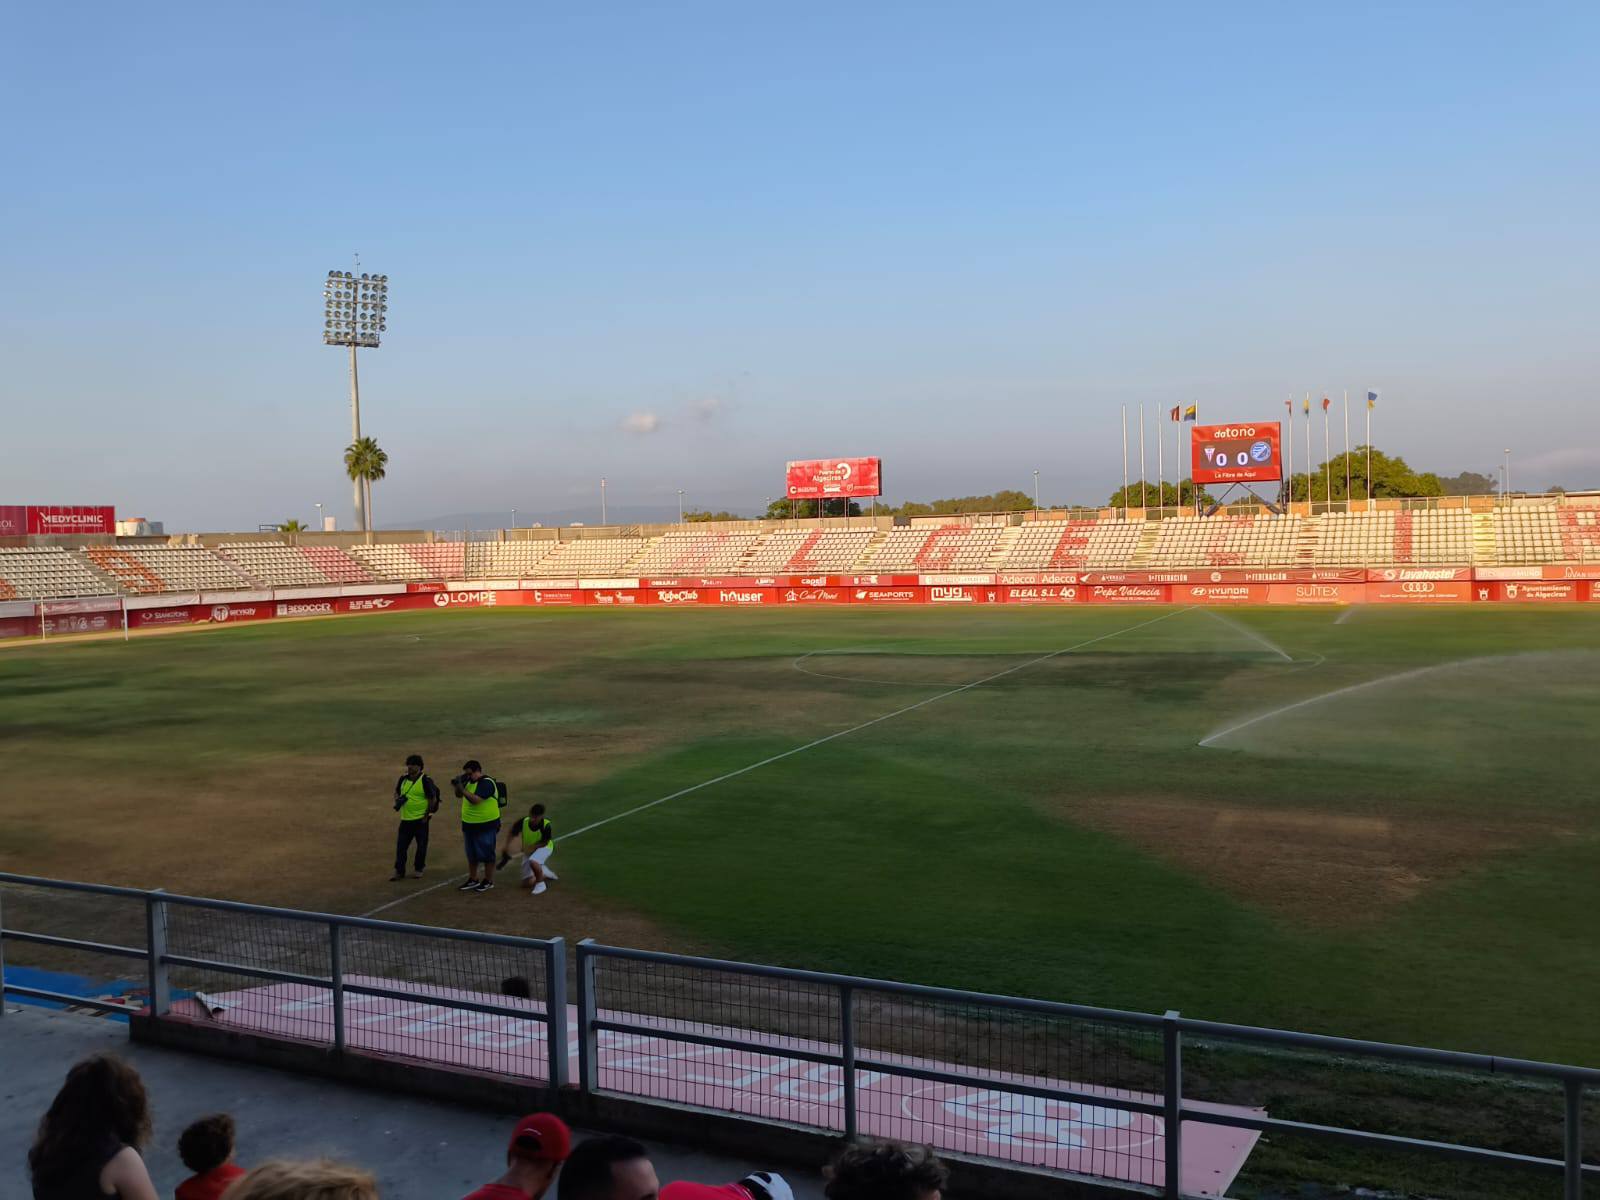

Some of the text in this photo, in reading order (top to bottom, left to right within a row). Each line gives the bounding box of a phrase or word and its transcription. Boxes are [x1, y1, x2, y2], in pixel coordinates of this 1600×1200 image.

[1216, 452, 1248, 466] 0 0
[40, 512, 103, 523] MEDYCLINIC
[1002, 574, 1036, 584] Adecco
[1042, 574, 1076, 584] Adecco
[1400, 569, 1456, 579] Lavahostel
[1010, 589, 1038, 597] ELEAL
[1094, 585, 1160, 597] Pepe Valencia
[1521, 585, 1571, 593] Ayuntamiento
[1535, 591, 1566, 599] Algeciras
[288, 603, 331, 613] BESOCCER
